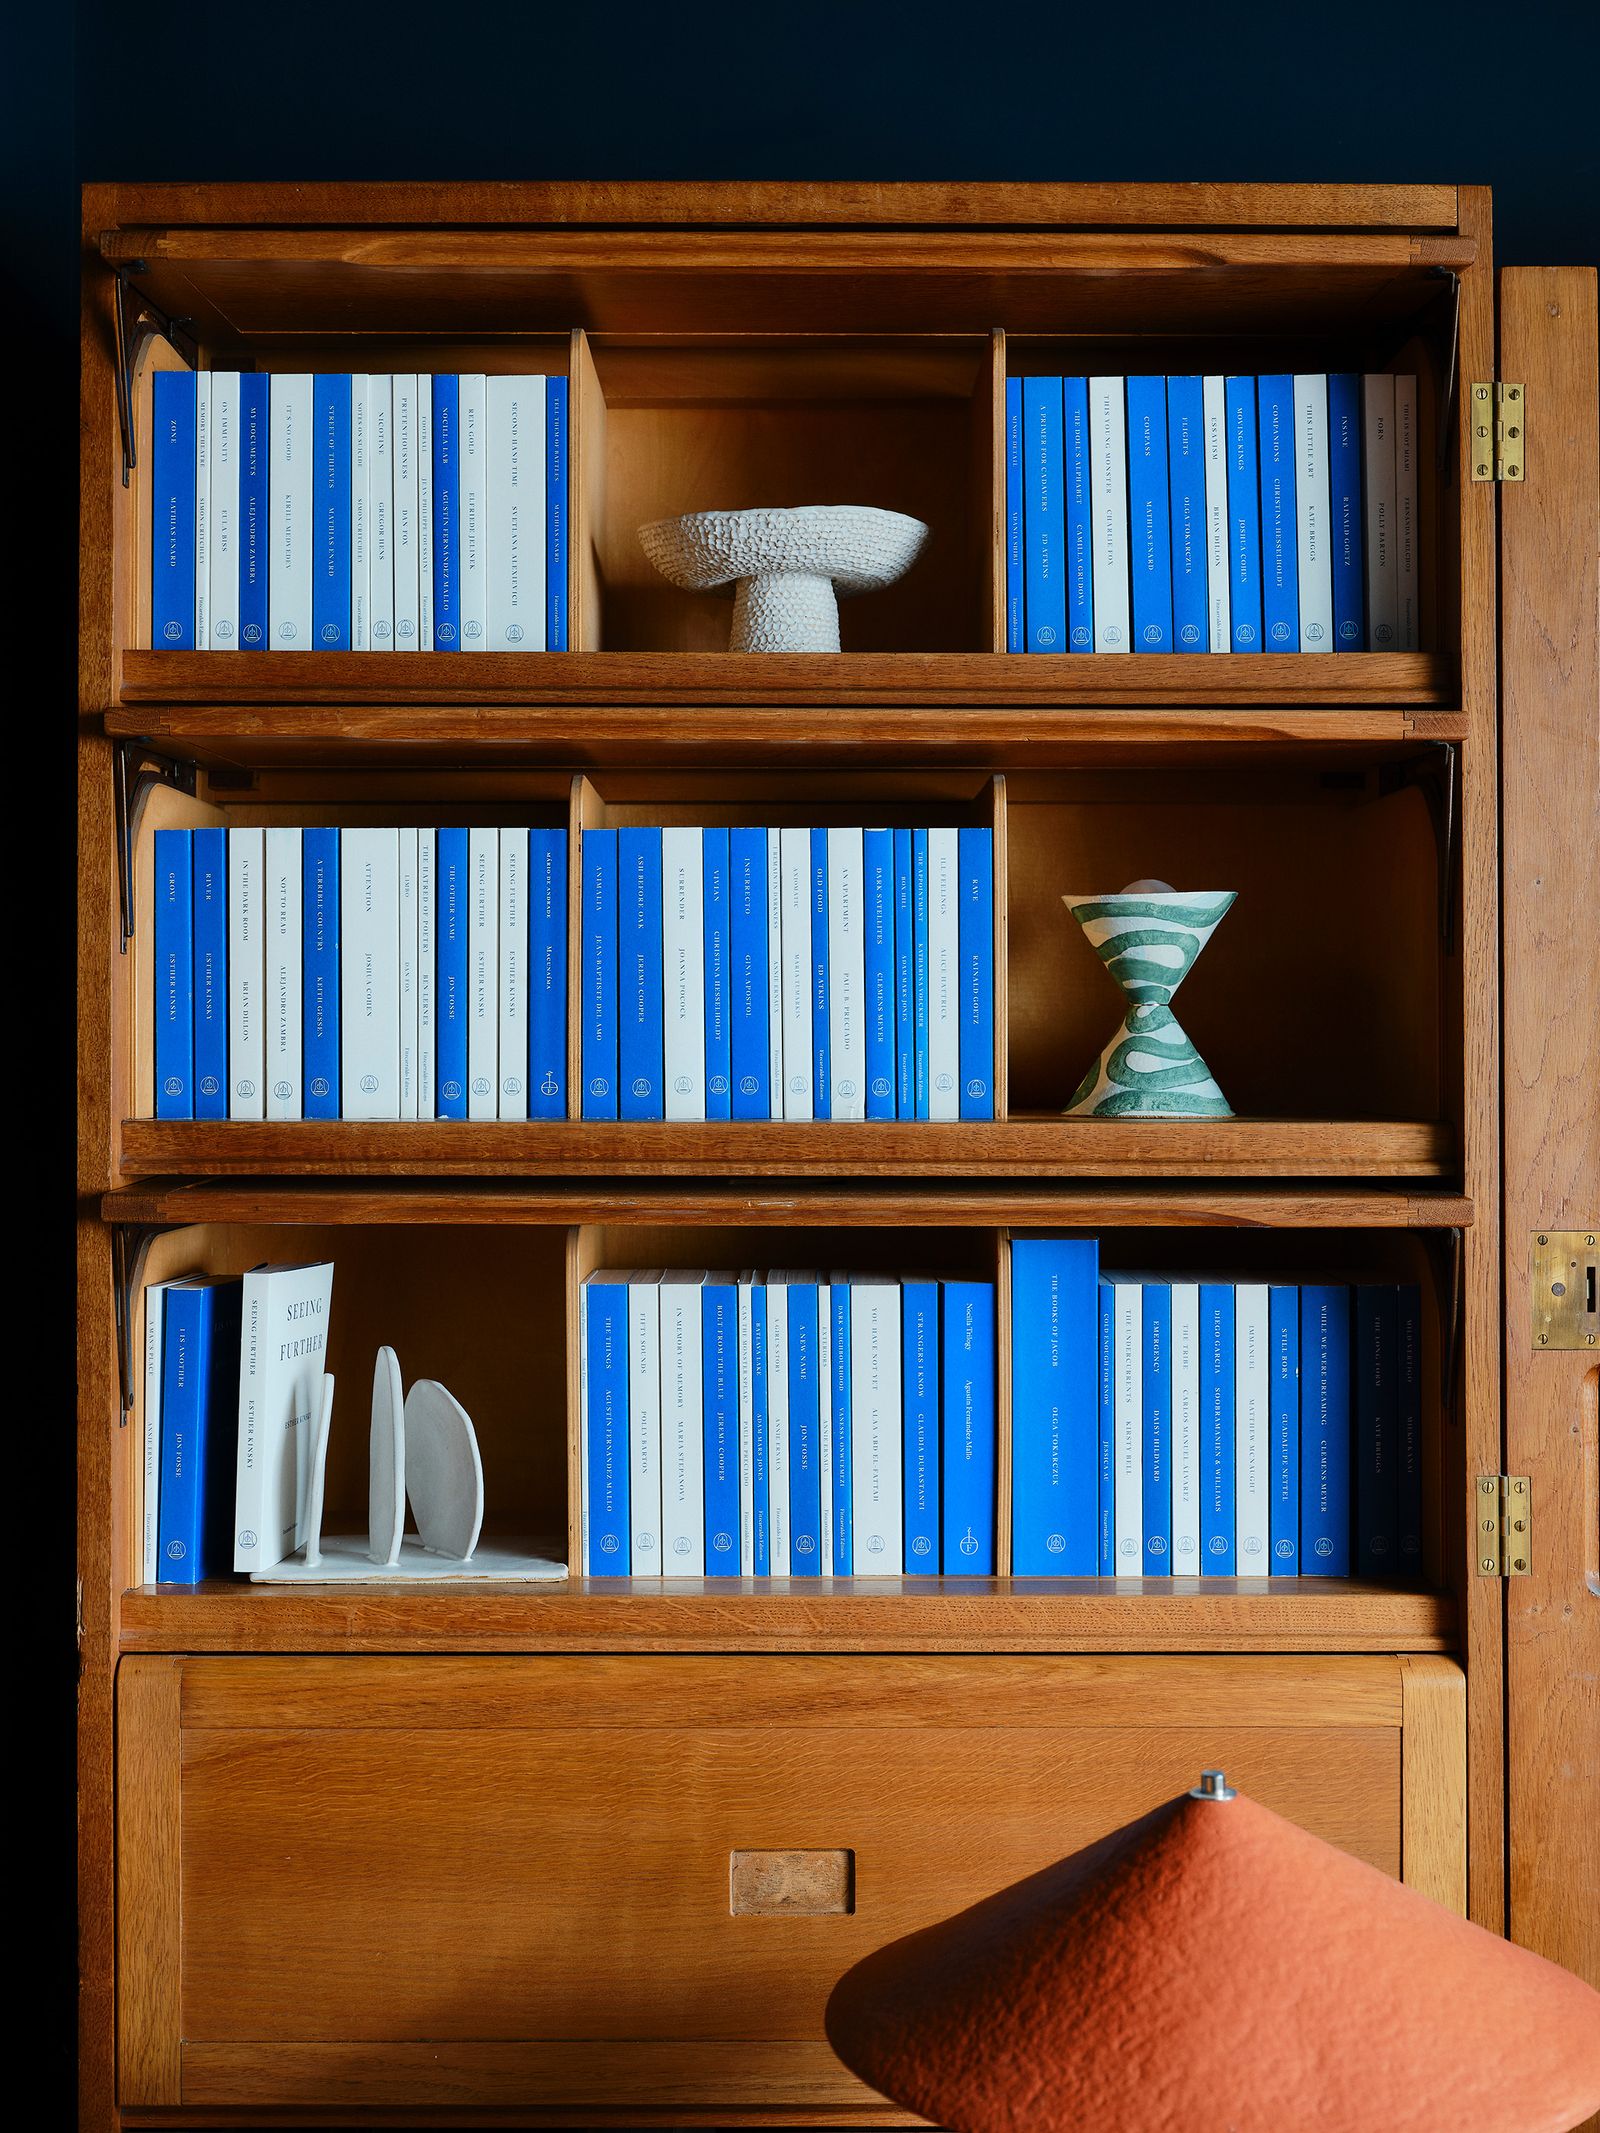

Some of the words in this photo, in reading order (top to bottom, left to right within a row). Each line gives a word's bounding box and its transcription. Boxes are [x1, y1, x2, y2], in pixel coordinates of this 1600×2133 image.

[250, 407, 257, 420] MY
[328, 439, 335, 450] OF
[1272, 404, 1280, 462] COMPANIONS
[249, 422, 257, 476] DOCUMENTS
[1237, 444, 1245, 471] KINGS
[1041, 534, 1048, 545] ED
[1184, 523, 1192, 575] TOKARCZUK
[1275, 528, 1283, 588] HESSELHOLDT
[280, 896, 287, 908] TO
[713, 930, 721, 978] CHRISTINA
[817, 964, 824, 976] ED
[447, 975, 455, 992] JON
[286, 1297, 323, 1322] SEEING
[965, 1303, 973, 1326] Nocilla
[179, 1334, 186, 1344] IS
[799, 1333, 807, 1352] NEW
[963, 1326, 973, 1351] Trilogy
[1051, 1325, 1058, 1337] OF
[249, 1335, 257, 1376] FURTHER
[279, 1333, 323, 1362] FURTHER
[1050, 1339, 1059, 1367] JACOB
[963, 1379, 973, 1406] Agustín
[247, 1400, 255, 1435] ESTHER
[717, 1412, 725, 1444] JEREMY
[965, 1406, 973, 1440] Fernández
[175, 1432, 183, 1449] JON
[800, 1424, 808, 1440] JON
[965, 1440, 973, 1460] Mallo
